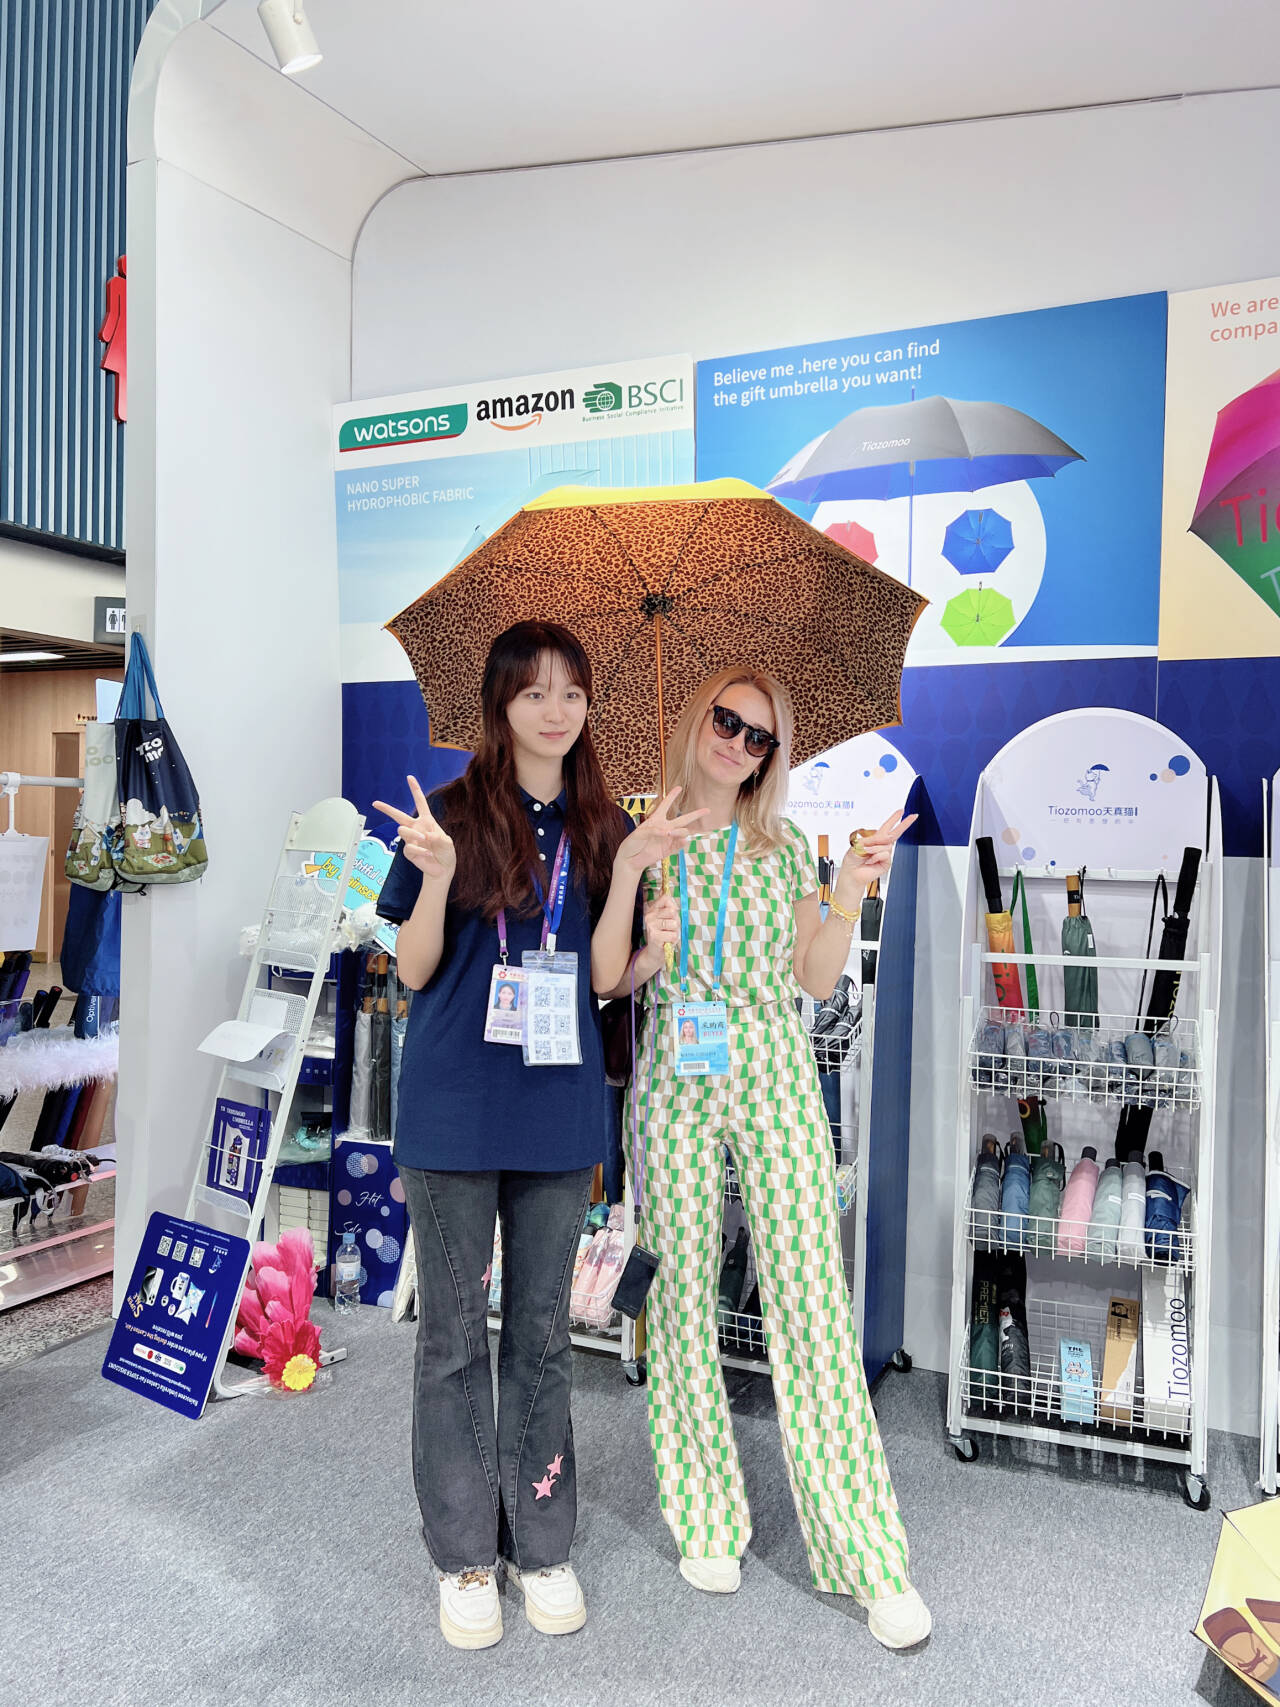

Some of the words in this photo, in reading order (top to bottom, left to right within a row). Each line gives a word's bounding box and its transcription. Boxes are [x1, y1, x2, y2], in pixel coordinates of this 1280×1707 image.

[1210, 300, 1241, 318] We
[1247, 297, 1280, 313] are
[713, 367, 767, 387] Believe
[770, 362, 794, 378] me
[841, 352, 870, 372] you
[873, 348, 903, 363] can
[907, 338, 940, 357] find
[628, 378, 684, 409] BSCI
[713, 390, 737, 407] the
[740, 386, 766, 406] gift
[769, 375, 839, 400] umbrella
[842, 374, 871, 393] you
[875, 363, 922, 383] want!
[476, 388, 574, 421] amazon
[353, 413, 450, 442] watsons
[346, 480, 379, 495] NANO
[382, 475, 420, 491] SUPER
[347, 491, 430, 513] HYDROPHOBIC
[432, 487, 475, 502] FABRIC
[321, 857, 340, 879] by
[355, 1191, 384, 1207] Hot
[1167, 1298, 1190, 1399] Tiozomoo
